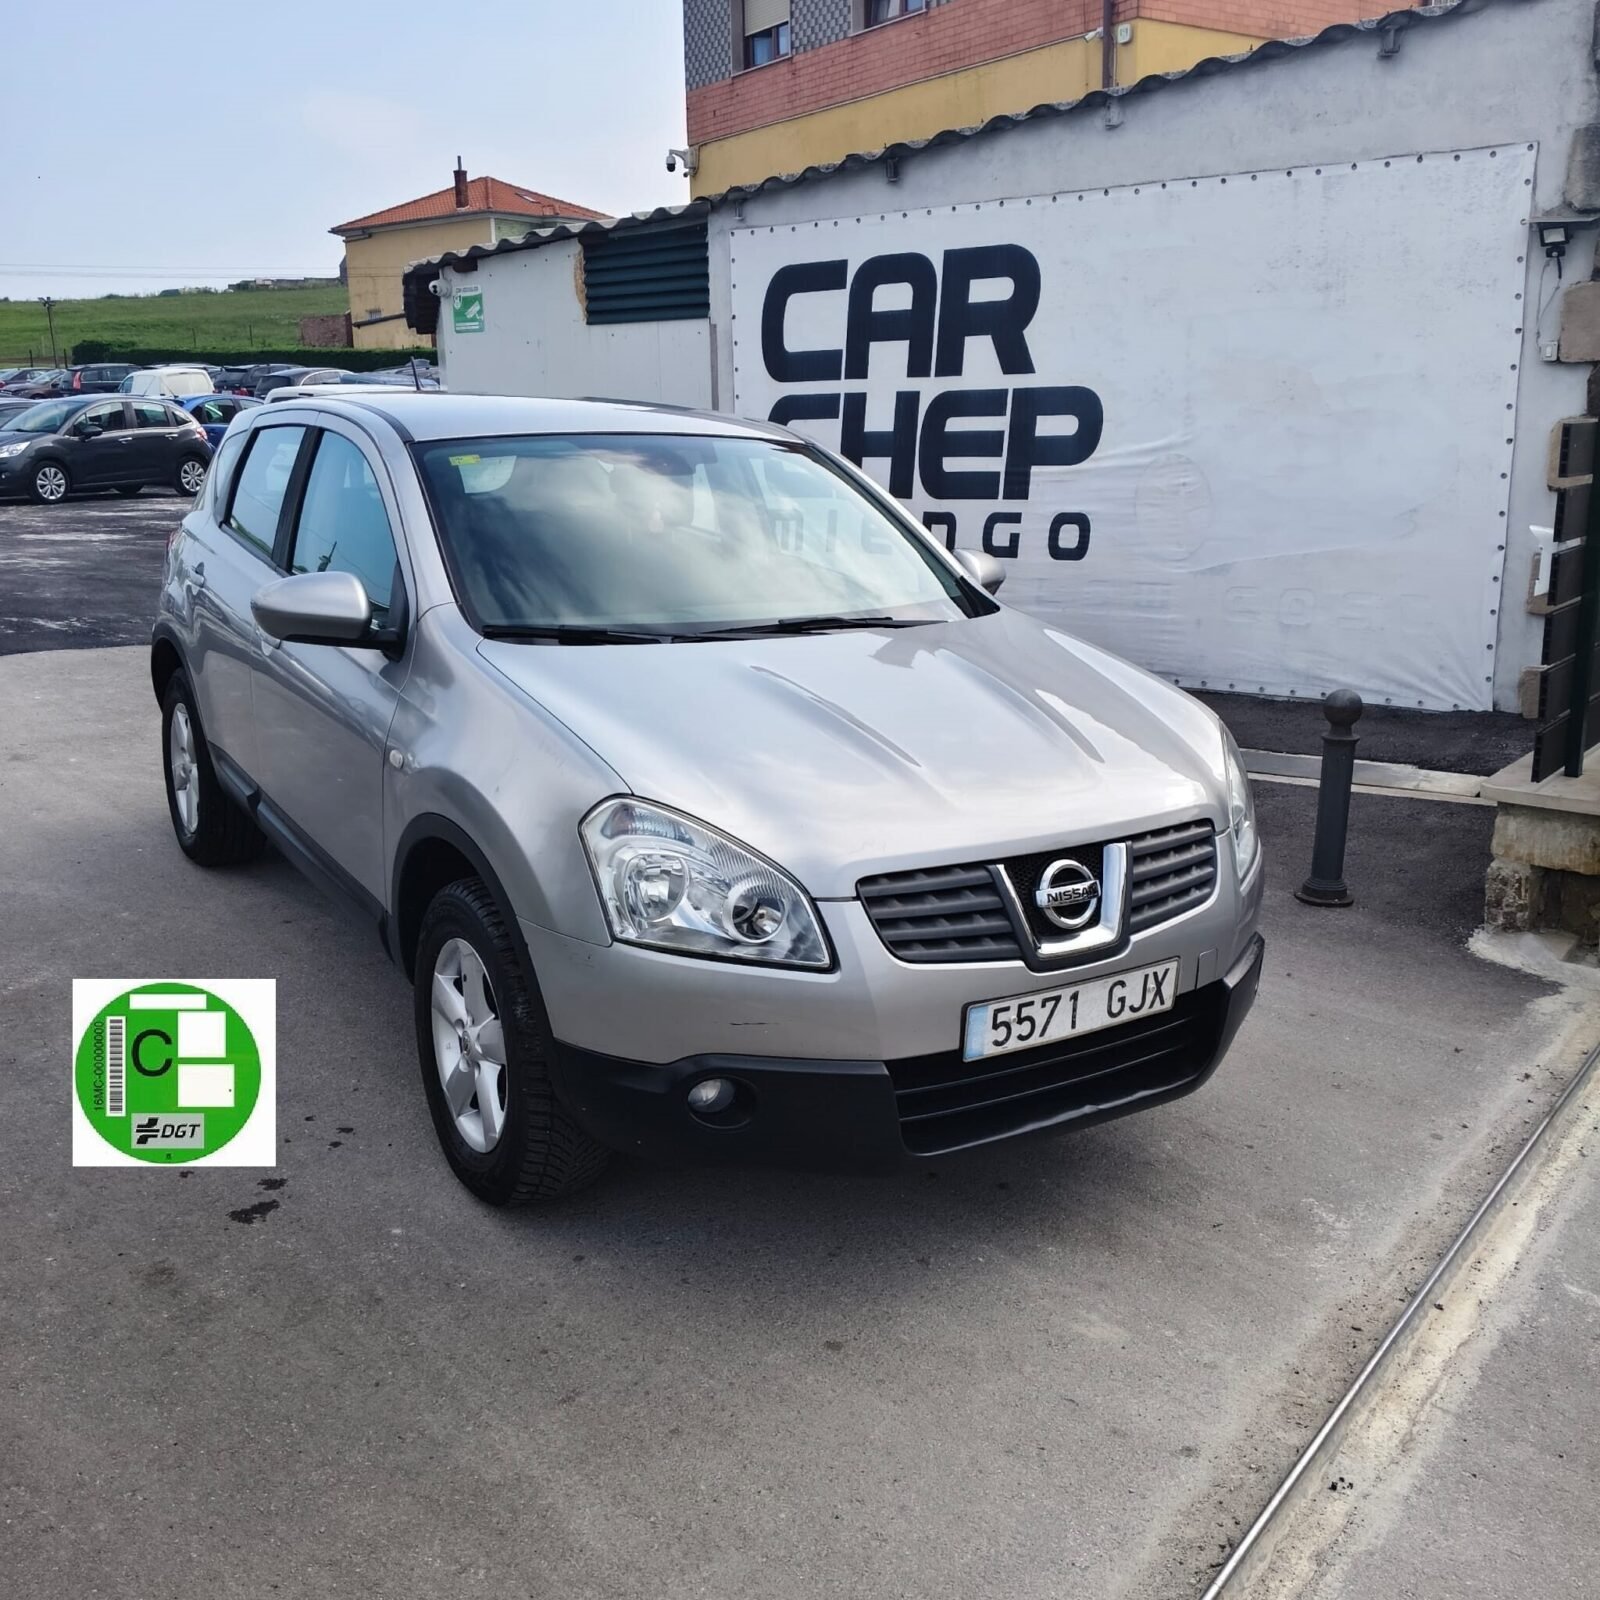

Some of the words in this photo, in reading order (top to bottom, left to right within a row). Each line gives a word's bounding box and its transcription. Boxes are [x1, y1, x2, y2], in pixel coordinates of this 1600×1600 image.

[761, 243, 1042, 383] CAR
[991, 990, 1080, 1048] 5571
[1106, 968, 1170, 1018] GJX
